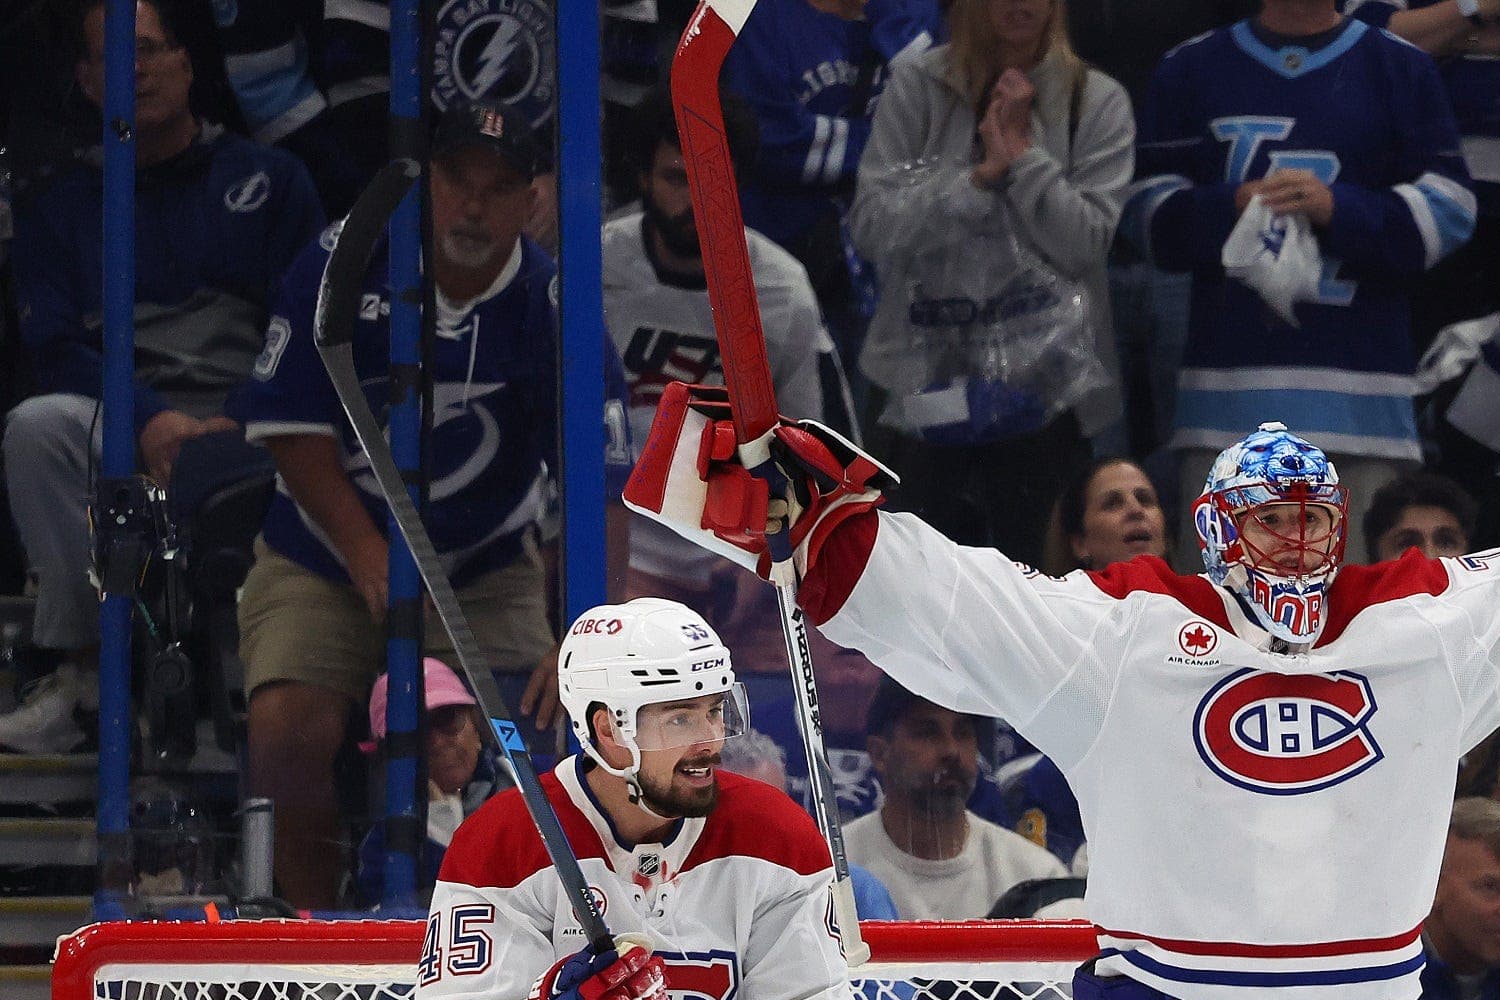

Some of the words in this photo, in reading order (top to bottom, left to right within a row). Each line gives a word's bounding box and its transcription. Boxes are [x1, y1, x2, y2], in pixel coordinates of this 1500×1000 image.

[572, 618, 606, 636] CIBC
[690, 657, 725, 672] CCM
[1167, 656, 1184, 664] AIR
[1184, 658, 1220, 666] CANADA
[580, 887, 597, 918] ALPHA
[562, 928, 578, 936] AIR
[417, 903, 496, 989] 45
